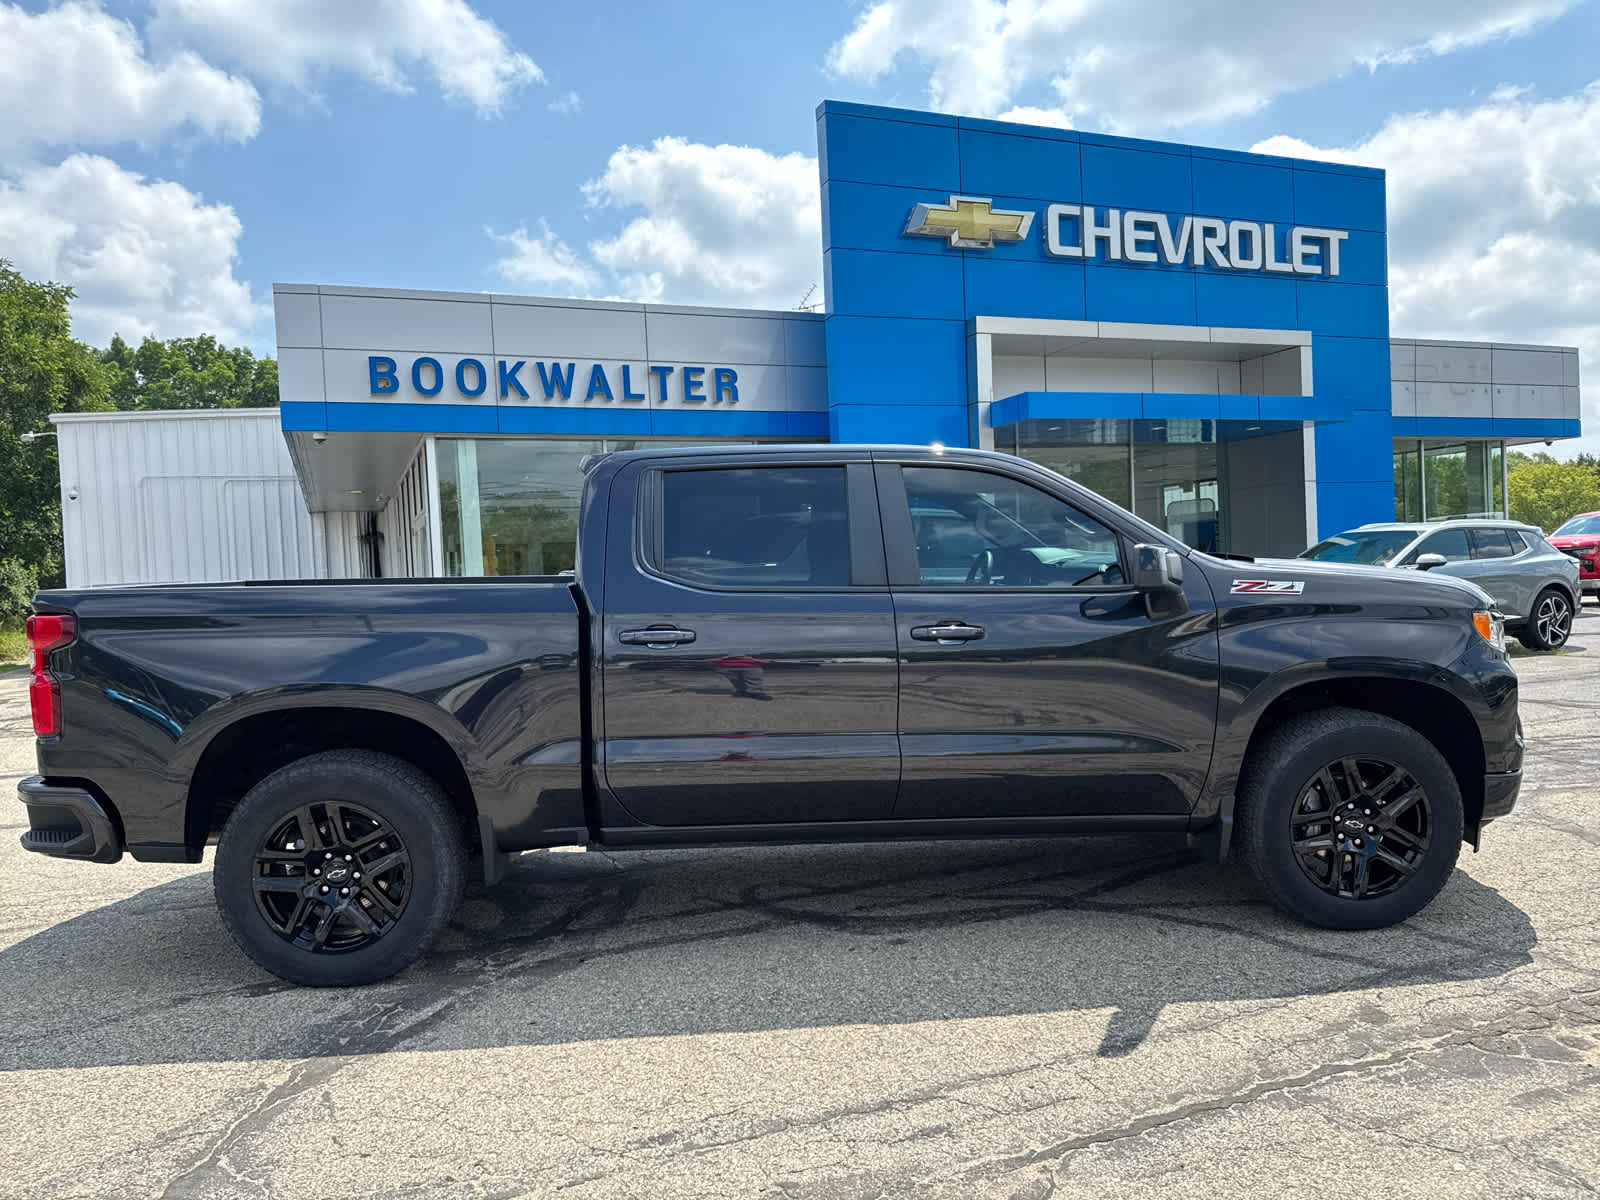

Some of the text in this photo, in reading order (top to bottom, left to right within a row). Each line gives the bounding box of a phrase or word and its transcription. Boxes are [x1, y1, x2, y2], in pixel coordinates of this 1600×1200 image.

[1044, 203, 1349, 278] CHEVROLET
[368, 356, 739, 403] BOOKWALTER
[1230, 579, 1305, 595] Z71
